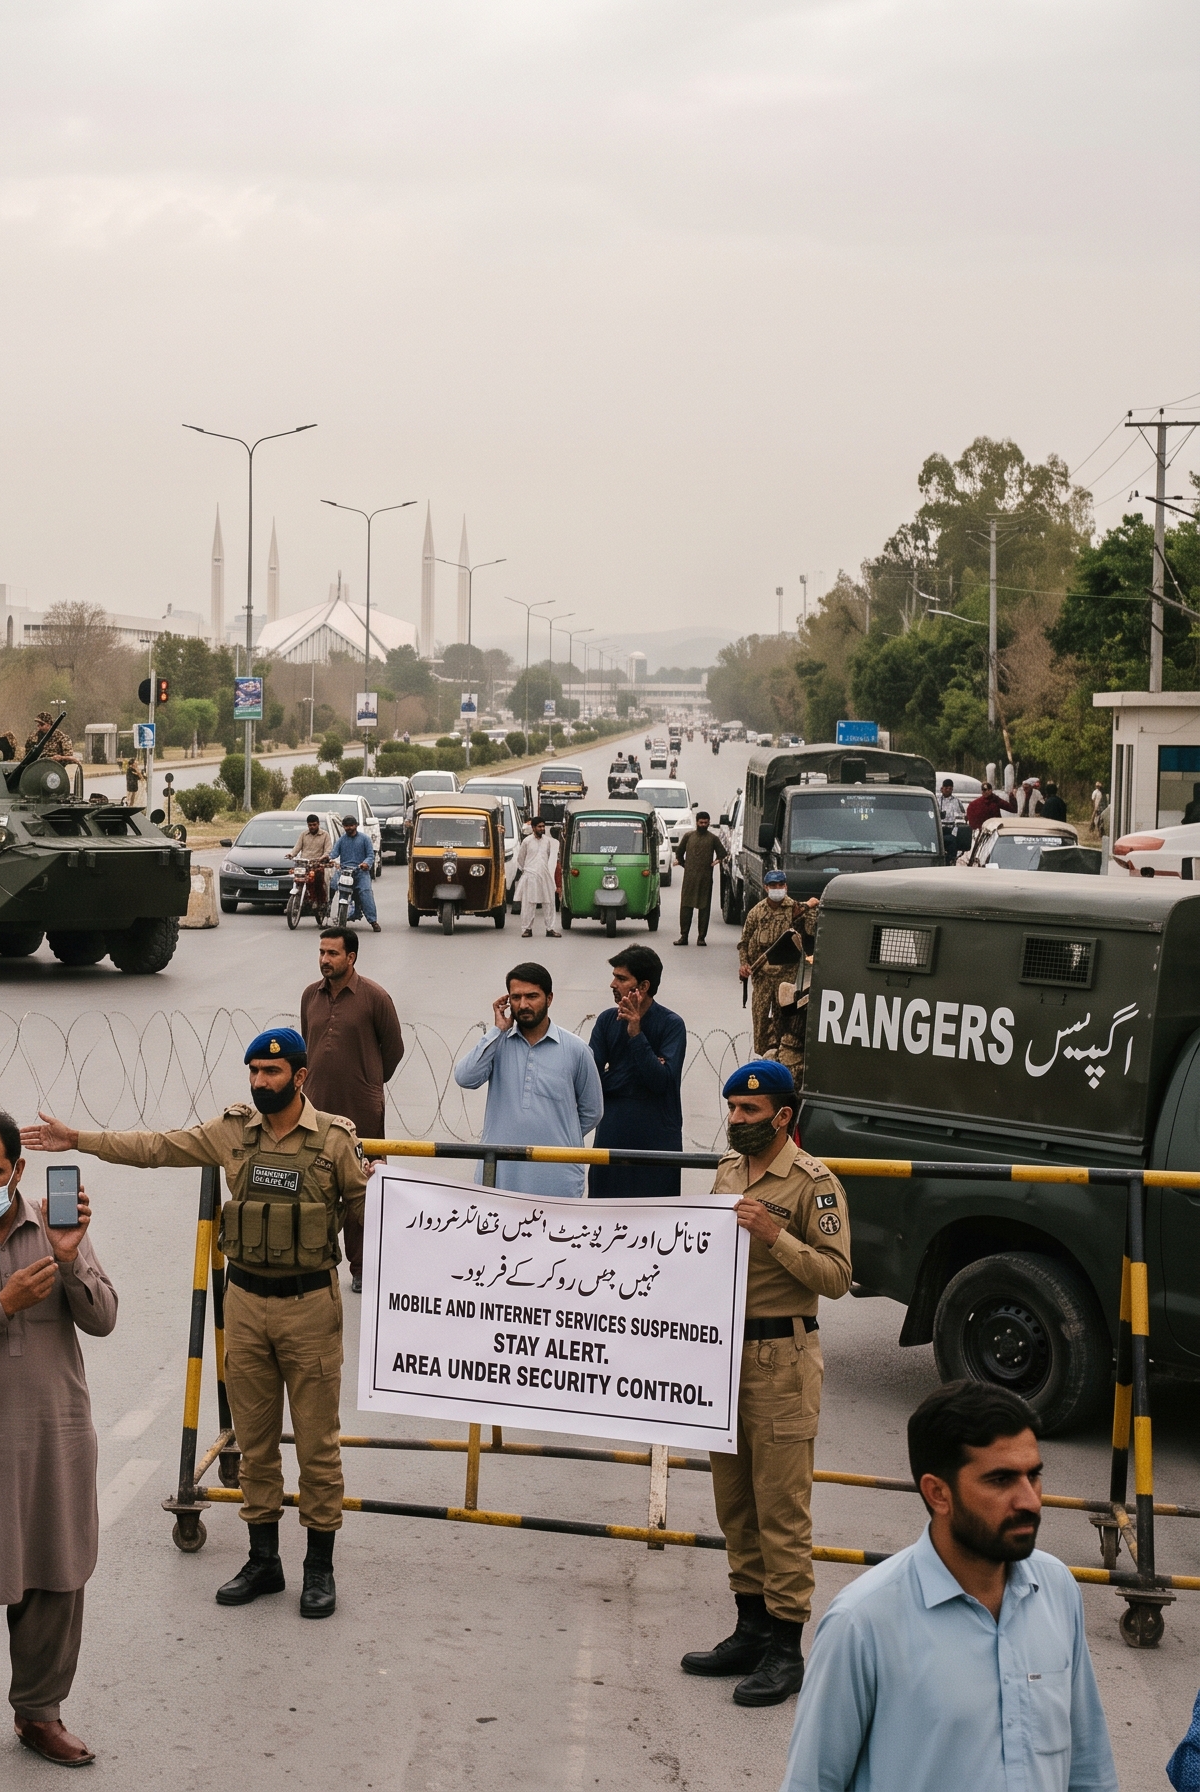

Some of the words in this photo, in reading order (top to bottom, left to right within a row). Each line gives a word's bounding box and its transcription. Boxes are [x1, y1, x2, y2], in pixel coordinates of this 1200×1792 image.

[817, 989, 1015, 1065] RANGERS
[388, 1292, 442, 1316] MOBILE
[445, 1299, 476, 1319] AND
[479, 1302, 552, 1327] INTERNET
[555, 1309, 627, 1335] SERVICES
[630, 1317, 723, 1346] SUSPENDED.
[493, 1332, 541, 1357] STAY
[544, 1338, 609, 1365] ALERT.
[392, 1352, 442, 1378] AREA
[448, 1358, 511, 1385] UNDER
[516, 1365, 612, 1396] SECURITY
[616, 1376, 714, 1408] CONTROL.
